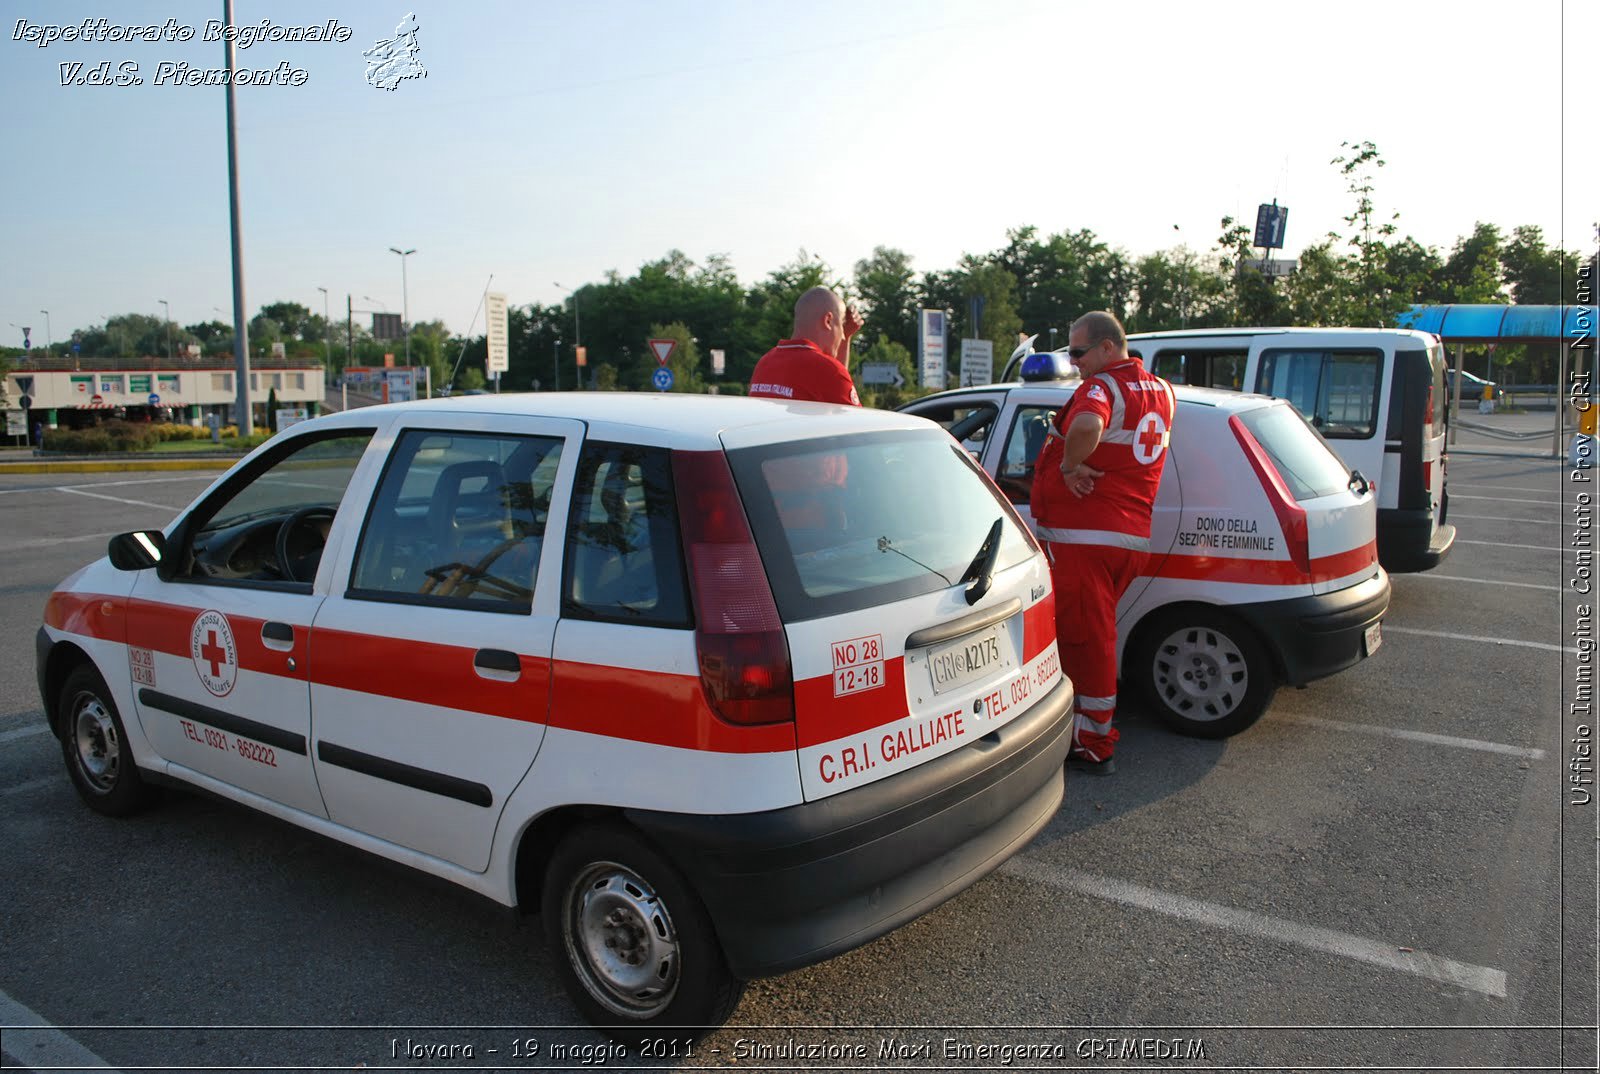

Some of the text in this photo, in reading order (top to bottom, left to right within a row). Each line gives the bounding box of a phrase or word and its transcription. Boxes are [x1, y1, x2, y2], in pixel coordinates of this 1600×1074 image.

[1196, 517, 1257, 534] DONO DELLA
[1179, 532, 1274, 551] SEZIONE FEMMINILE
[193, 615, 234, 666] CROCE ROSSA ITALIANA
[835, 639, 878, 664] NO 28
[131, 650, 152, 666] NO 28
[933, 636, 999, 684] CRI A2173
[203, 674, 231, 692] GALLIATE
[838, 666, 879, 691] 12-18
[819, 742, 876, 783] C.R.I.
[881, 710, 965, 762] GALLIATE
[983, 688, 1010, 719] TEL.
[1010, 671, 1032, 705] 0321
[180, 720, 204, 743] TEL.
[204, 729, 229, 751] 0321
[237, 738, 277, 767] 862222
